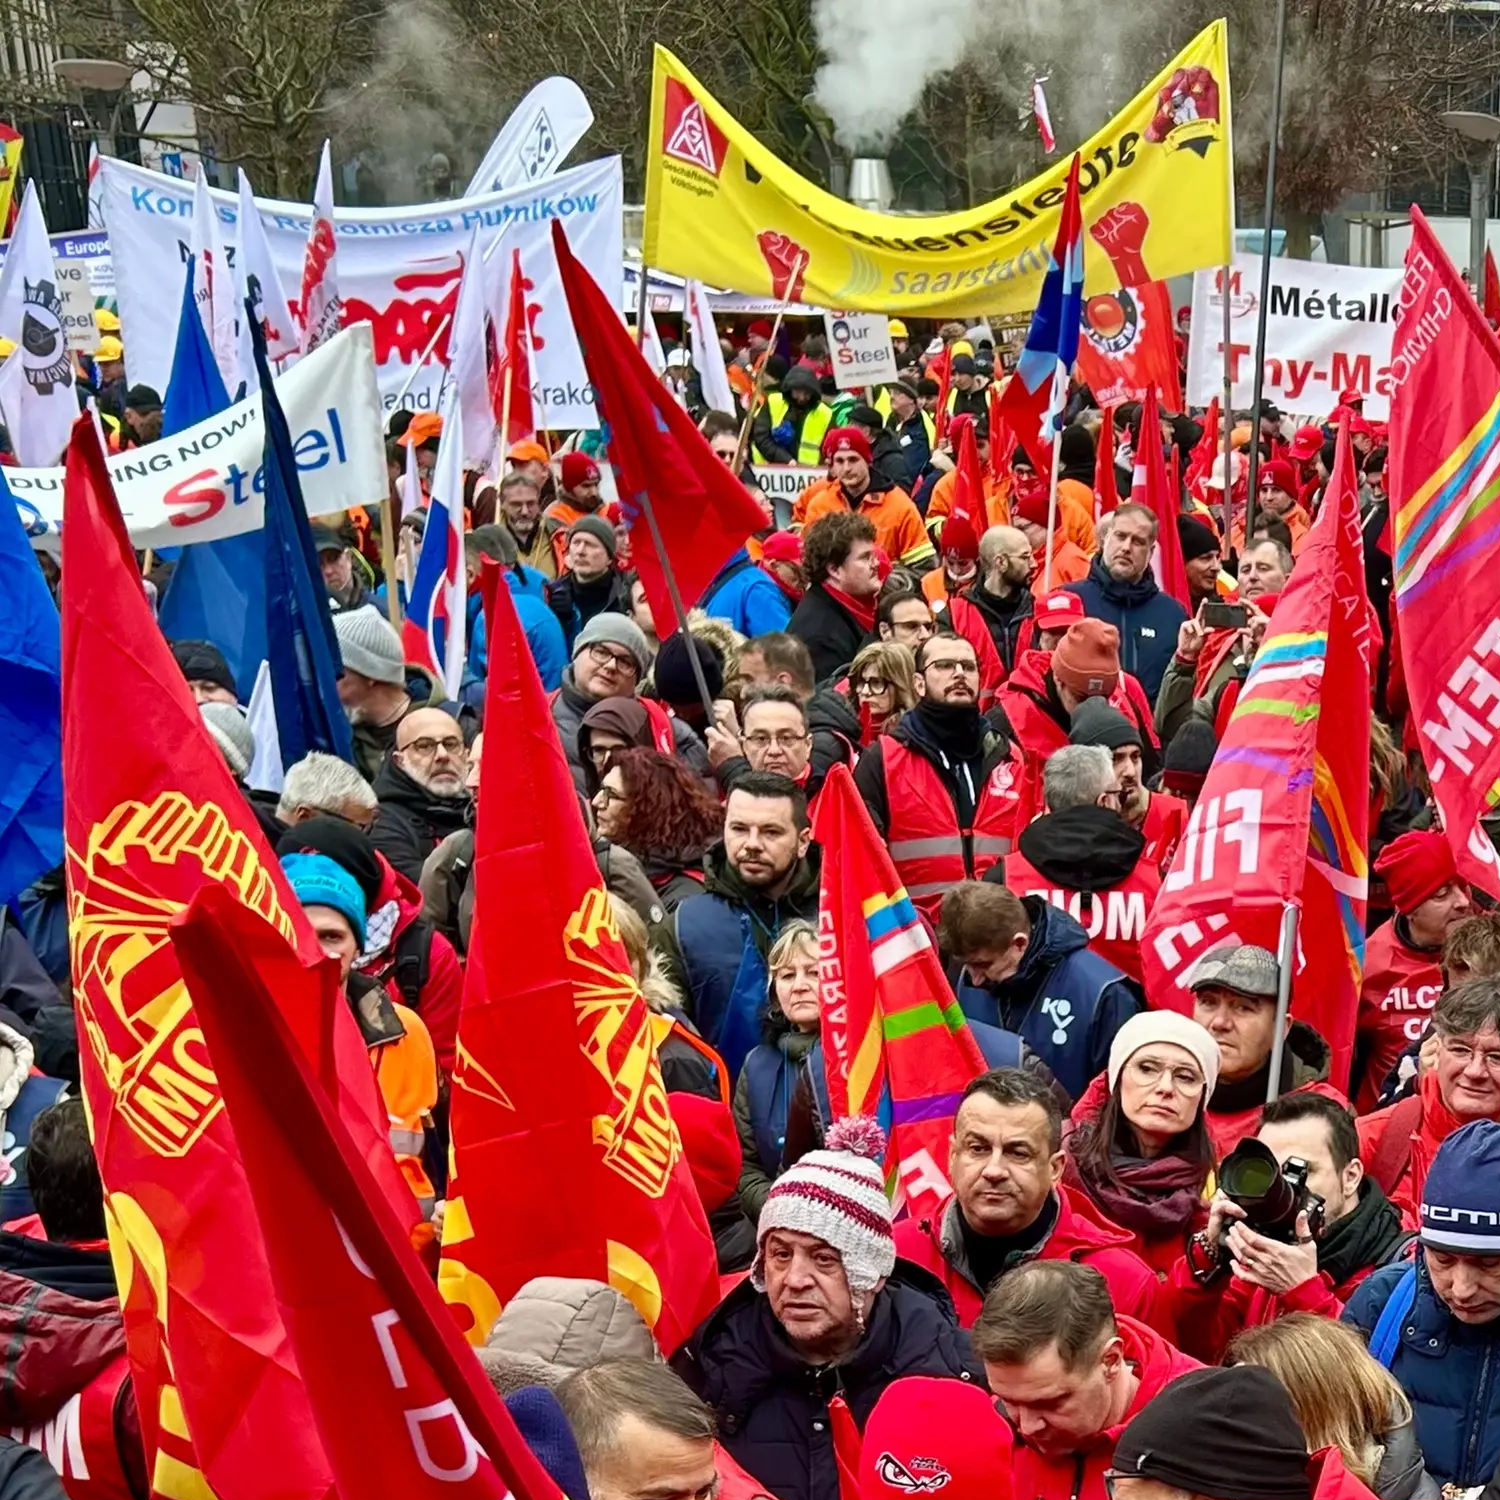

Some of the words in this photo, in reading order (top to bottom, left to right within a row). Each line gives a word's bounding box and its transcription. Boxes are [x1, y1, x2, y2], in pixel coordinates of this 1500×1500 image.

[461, 192, 599, 230] Hutników
[833, 320, 870, 343] Our
[838, 347, 891, 366] Steel
[178, 409, 257, 462] NOW!
